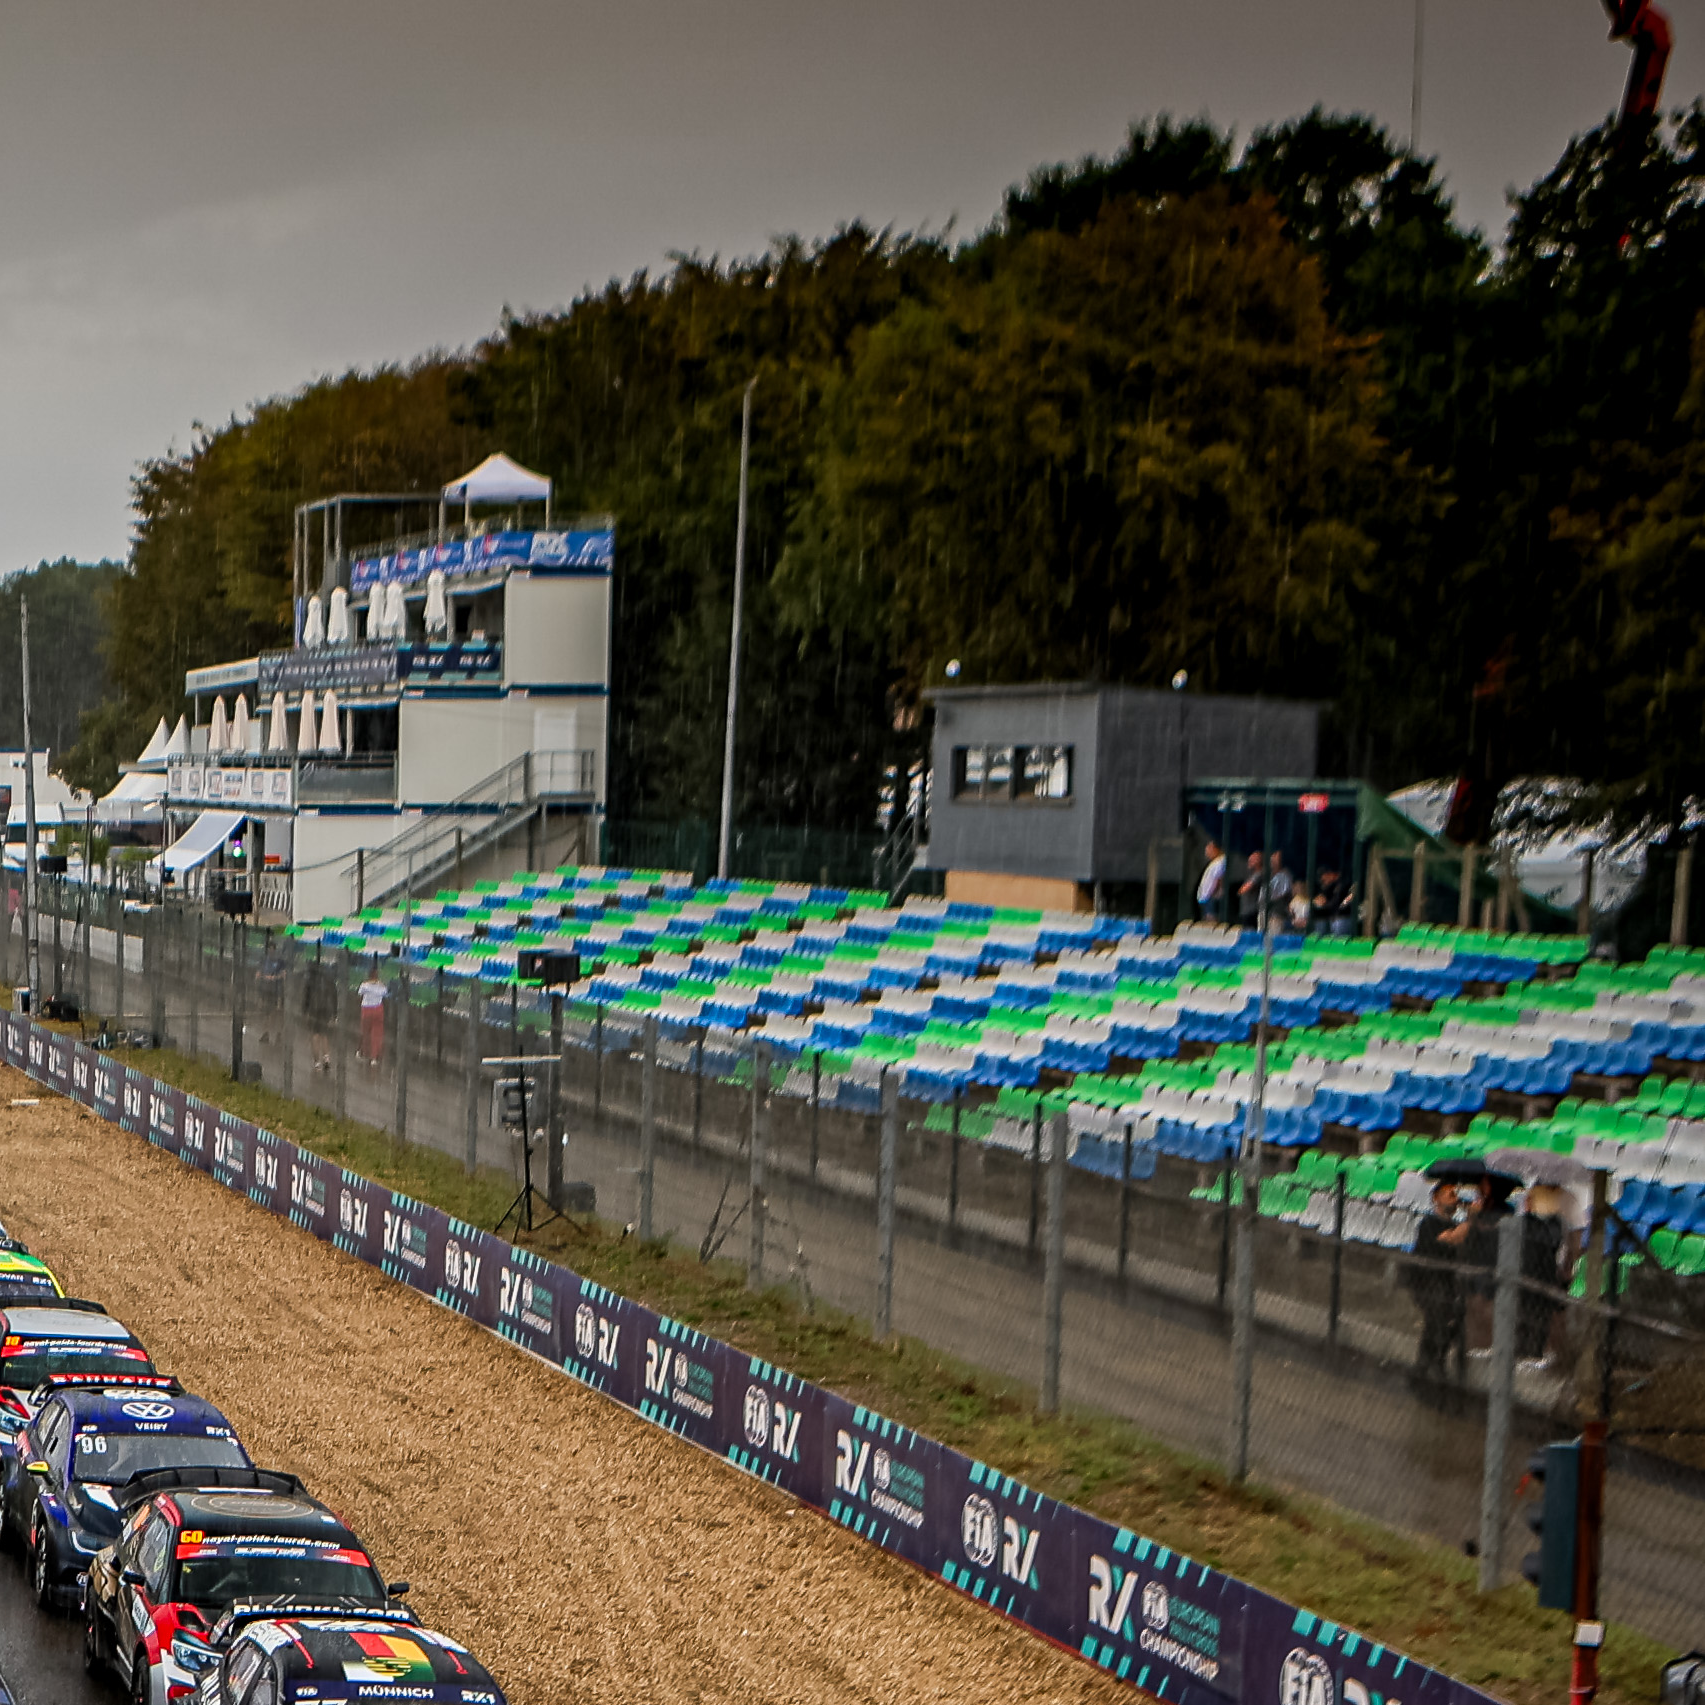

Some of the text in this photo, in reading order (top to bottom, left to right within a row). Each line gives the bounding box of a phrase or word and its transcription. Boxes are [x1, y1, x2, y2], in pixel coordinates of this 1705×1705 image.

[134, 1422, 168, 1431] VEIBY
[80, 1437, 107, 1453] 96
[180, 1530, 203, 1544] 60
[358, 1685, 434, 1699] MÜNNICH
